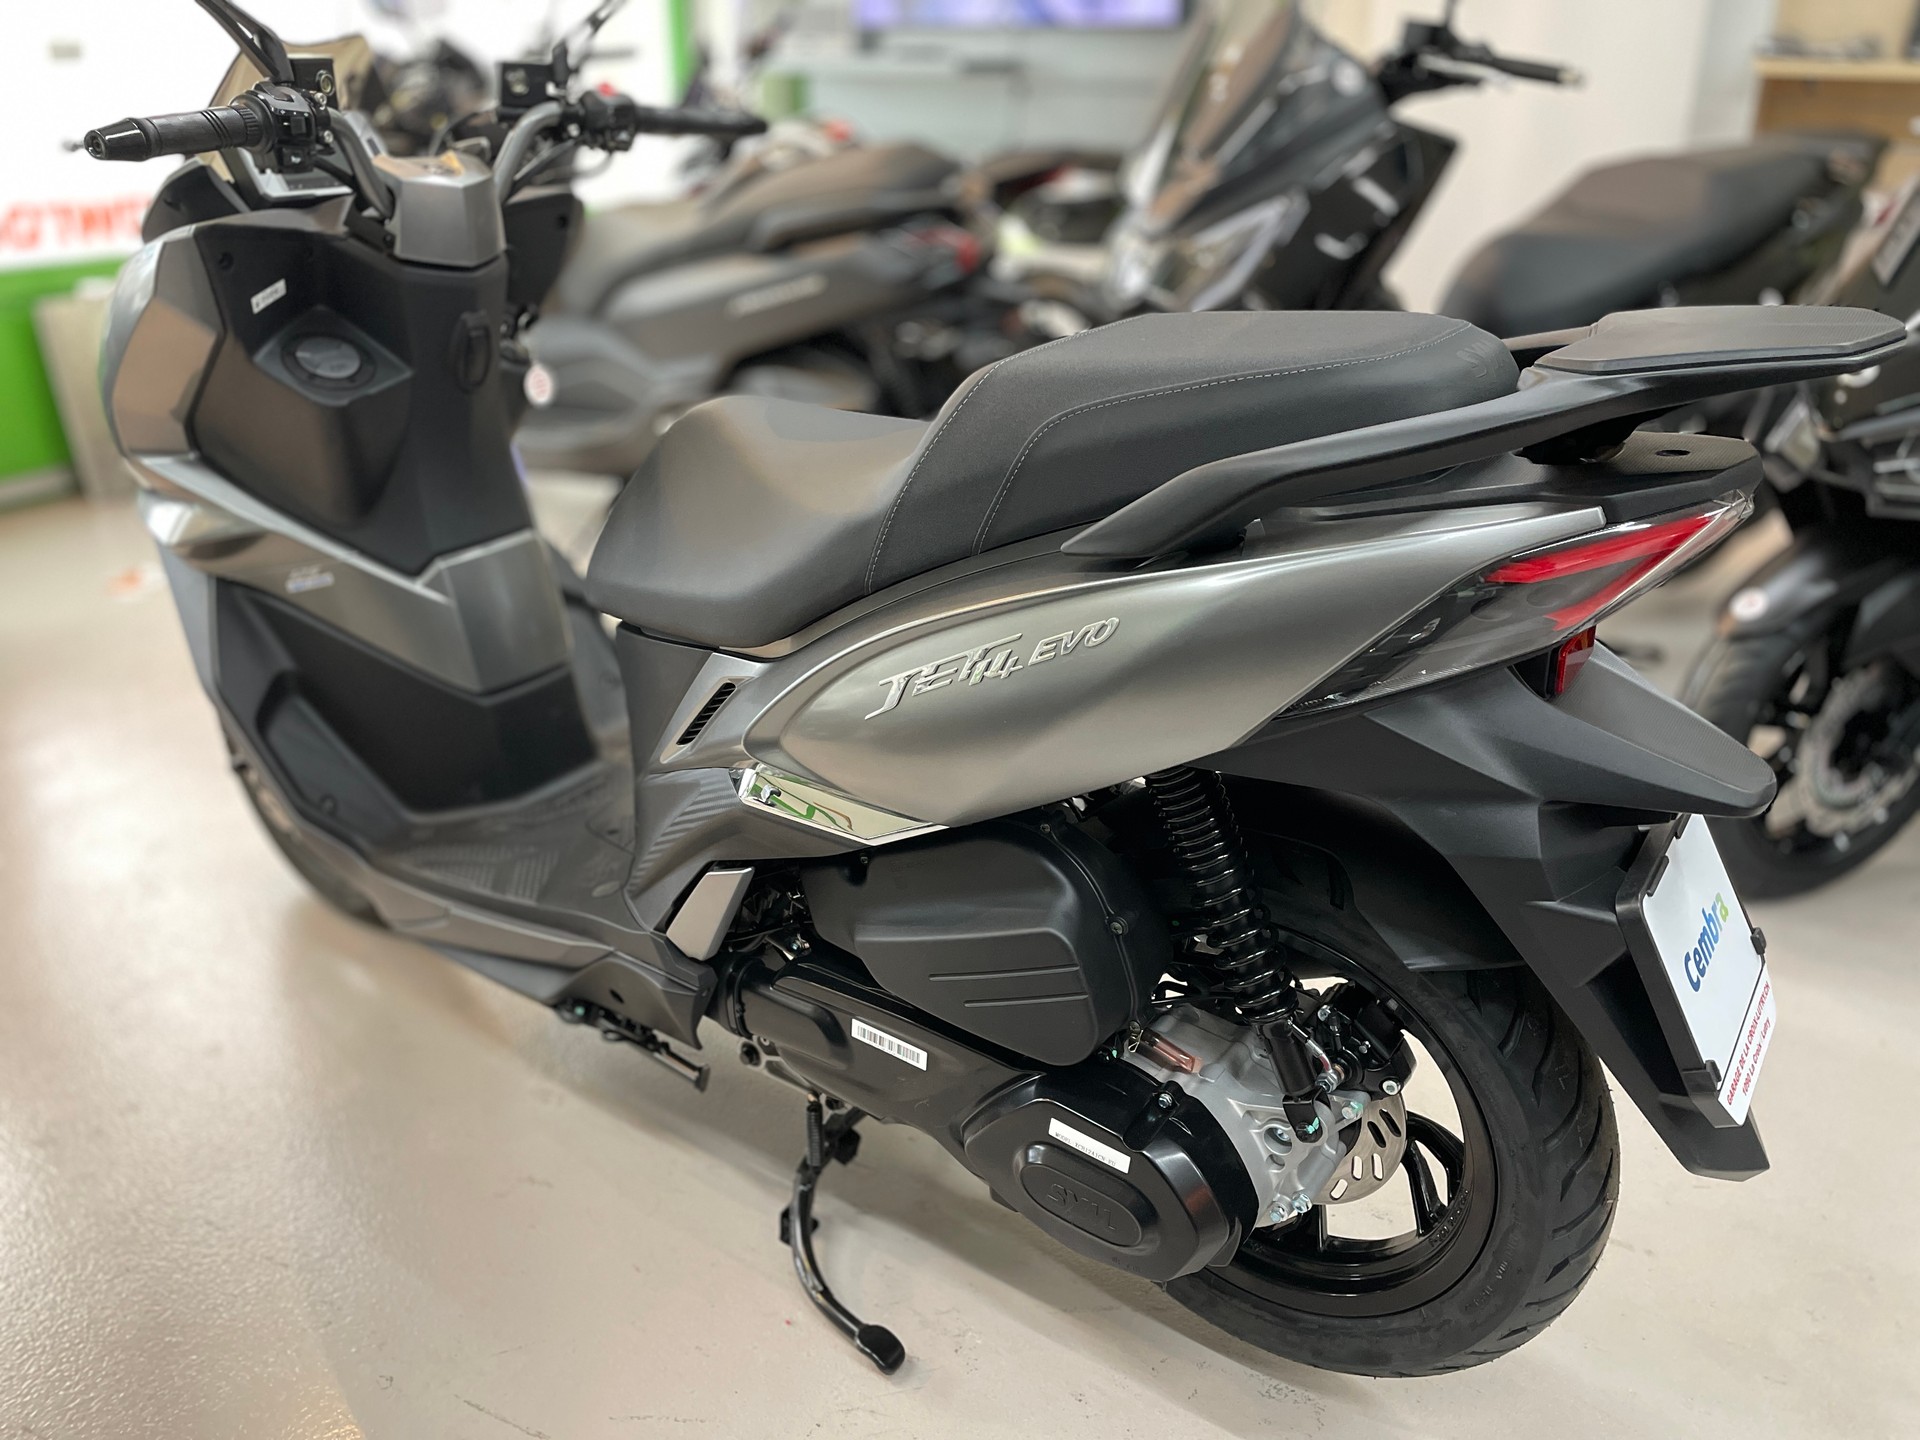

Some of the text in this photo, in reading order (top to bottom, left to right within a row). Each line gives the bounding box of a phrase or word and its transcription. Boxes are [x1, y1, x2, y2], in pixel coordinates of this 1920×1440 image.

[1027, 617, 1120, 666] EVO
[1684, 892, 1729, 992] Cembra
[1727, 1066, 1742, 1105] GARAGE
[1742, 1072, 1751, 1096] 1090
[1753, 1043, 1762, 1064] Croix
[1760, 1016, 1771, 1039] Lutry
